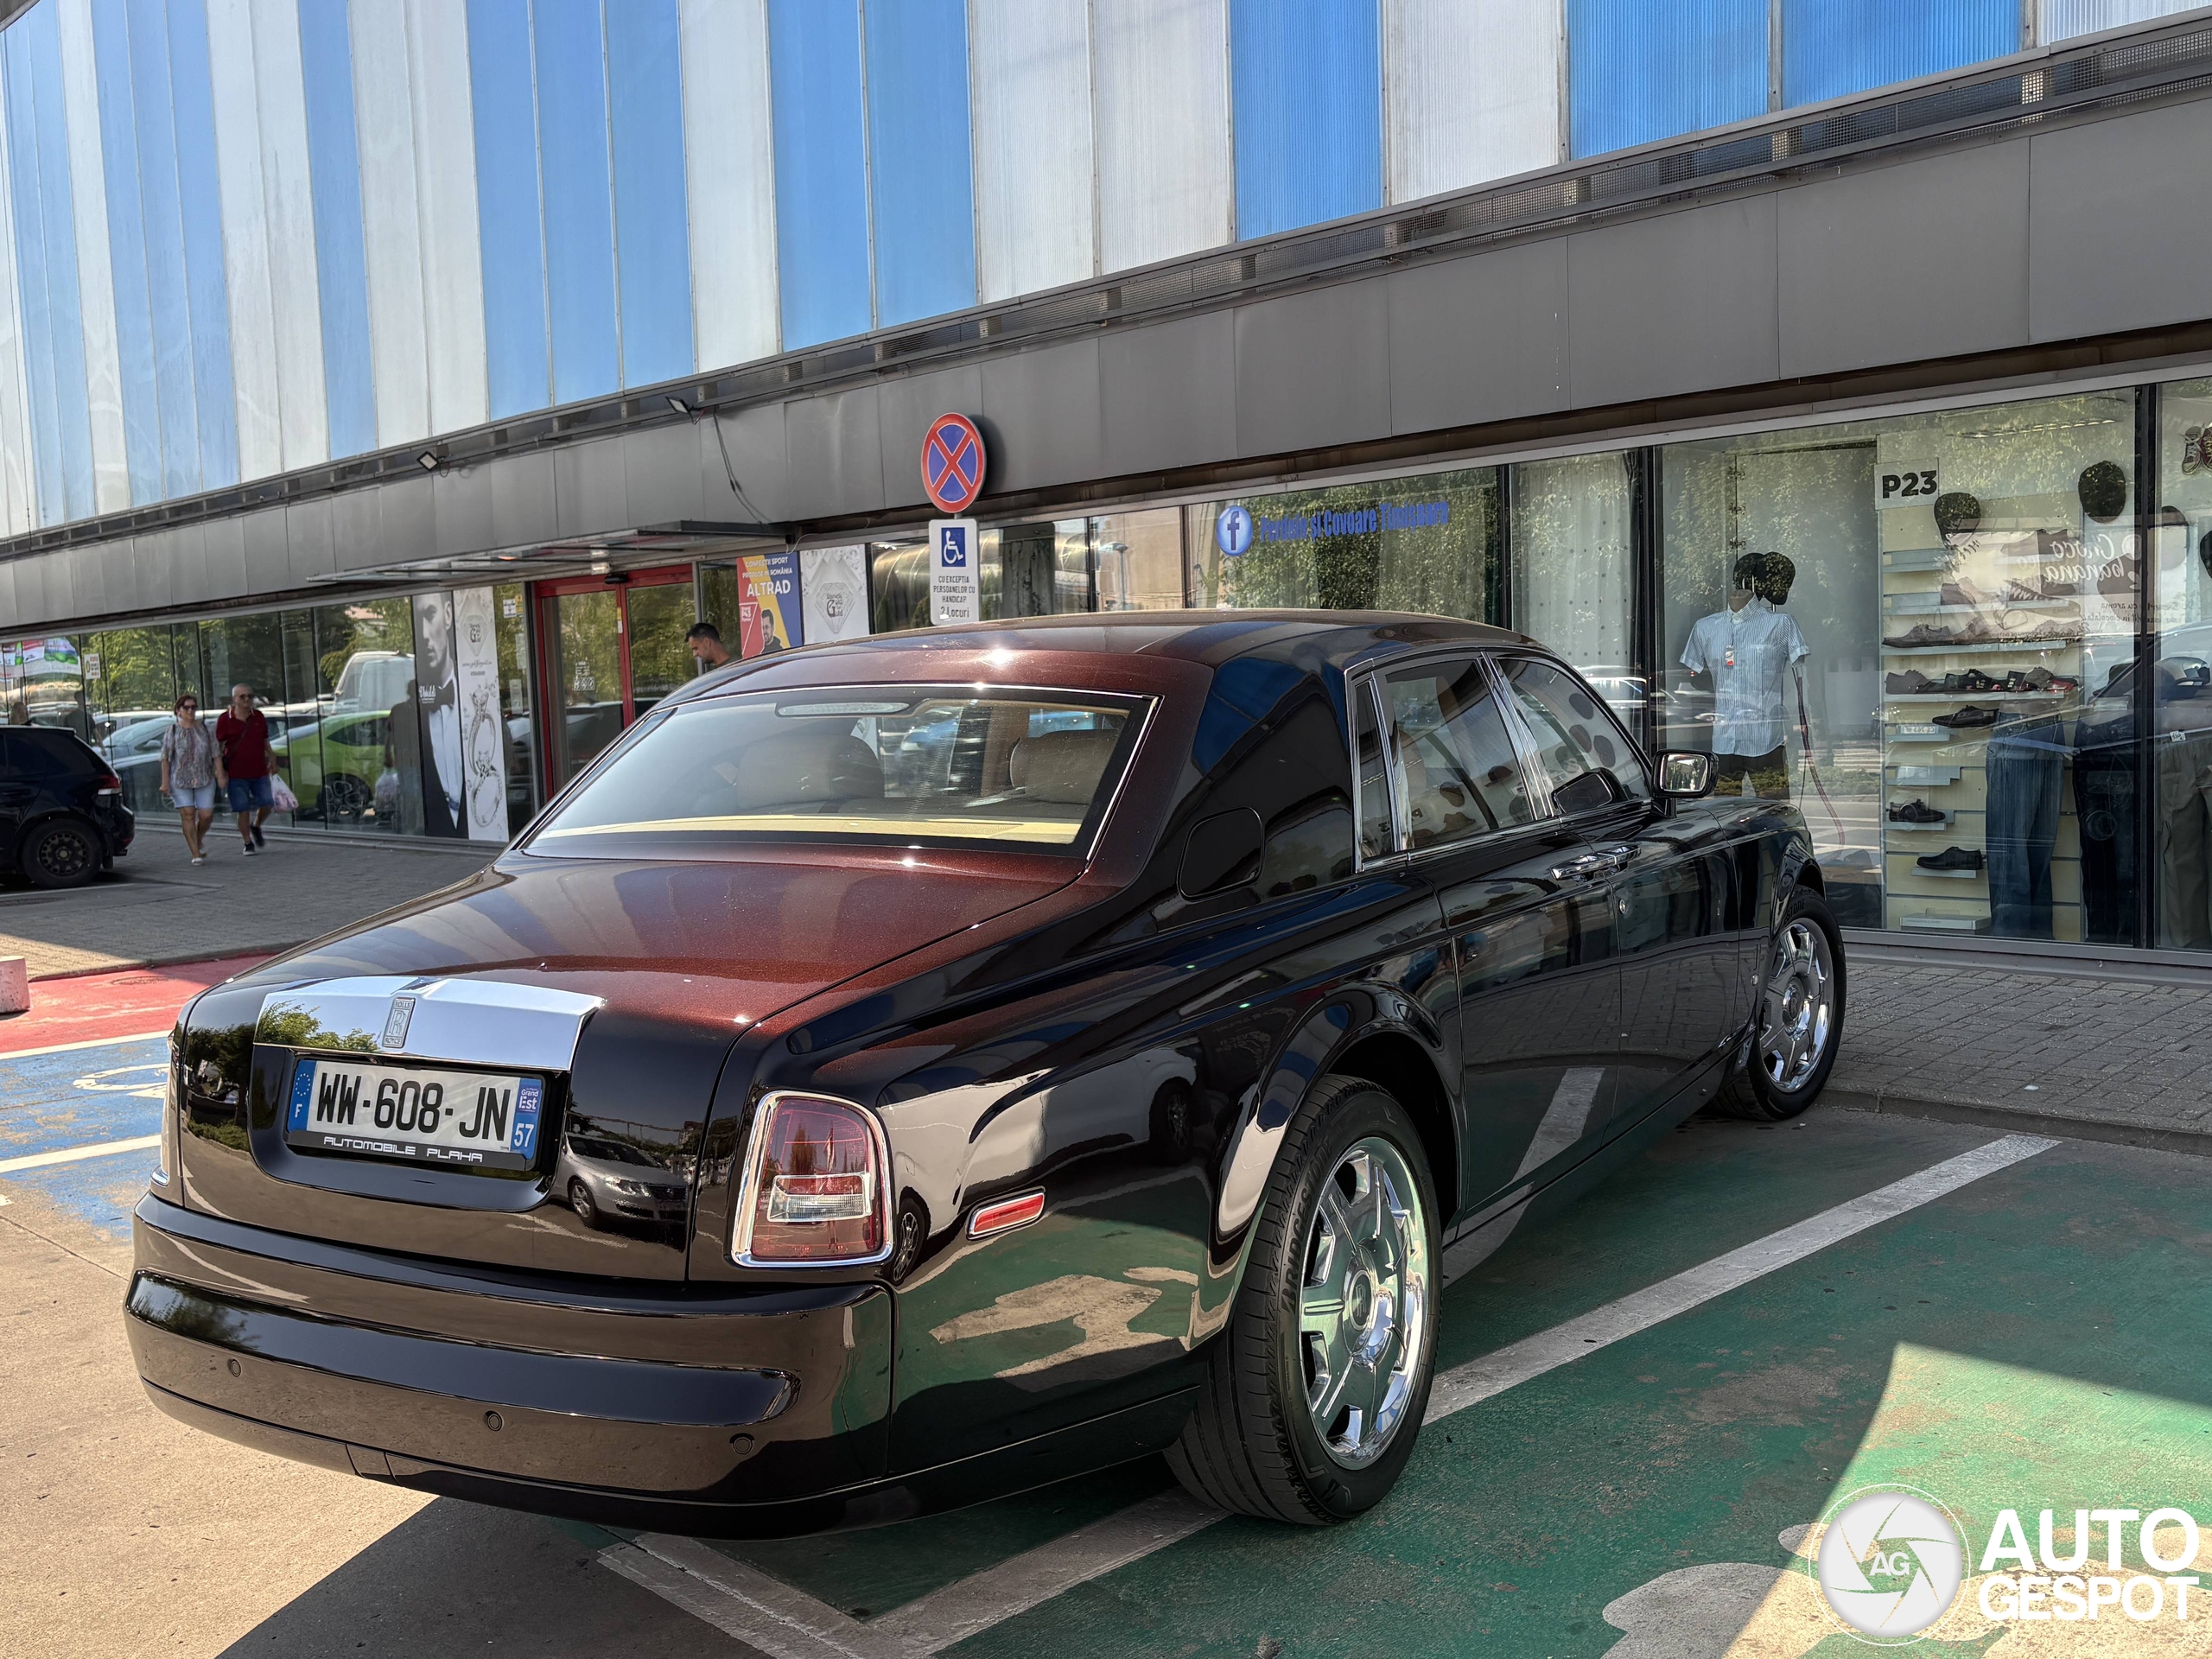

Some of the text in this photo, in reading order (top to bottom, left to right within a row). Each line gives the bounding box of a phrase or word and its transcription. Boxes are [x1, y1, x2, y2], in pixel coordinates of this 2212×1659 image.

[1882, 470, 1937, 499] P23
[1227, 511, 1240, 550] f
[1324, 507, 1378, 537] Covoare
[772, 556, 788, 565] SPORT
[771, 567, 792, 575] ROMÂNIA
[747, 580, 791, 597] ALTRAD
[518, 1096, 537, 1109] Est
[521, 1089, 538, 1097] Grand
[295, 1103, 302, 1118] F
[514, 1123, 534, 1147] 57
[324, 1136, 483, 1163] AUTOMOBILE PLAHA
[1282, 1135, 1333, 1316] BRIDGESTONE
